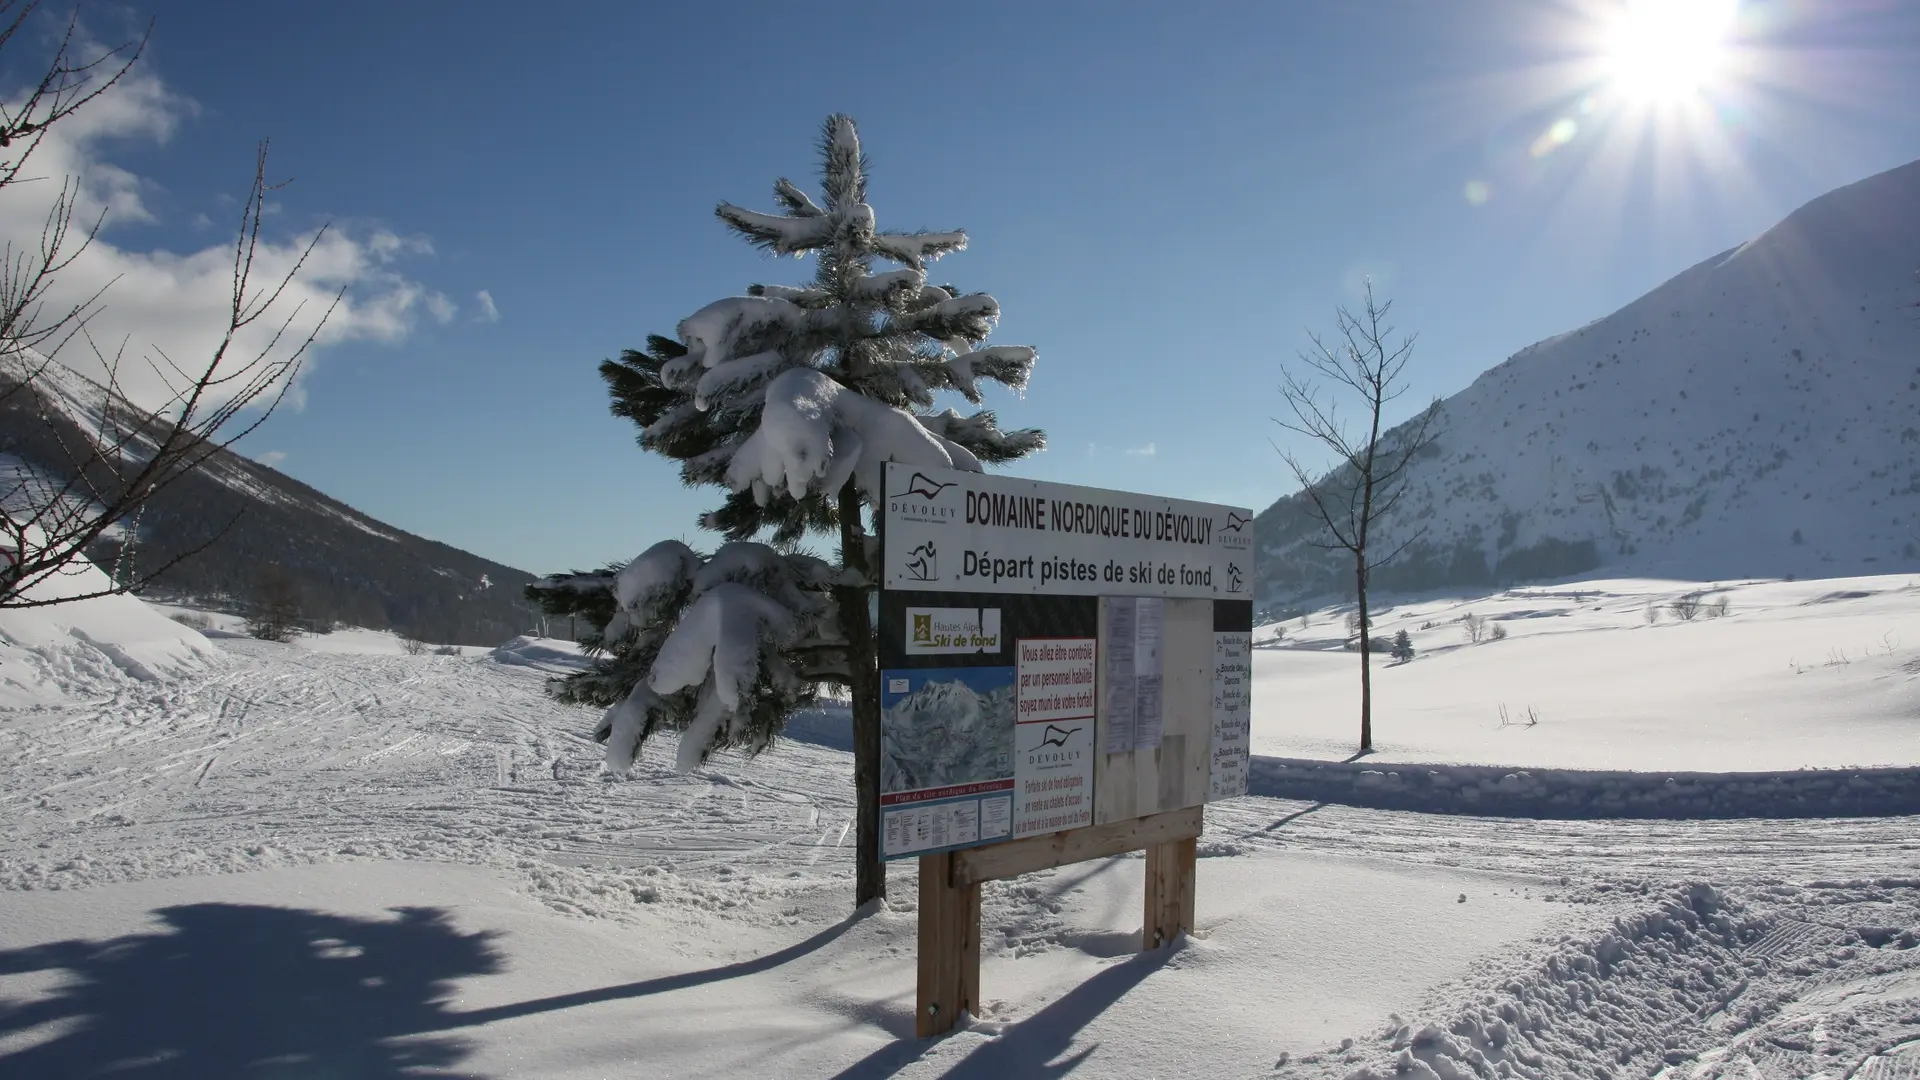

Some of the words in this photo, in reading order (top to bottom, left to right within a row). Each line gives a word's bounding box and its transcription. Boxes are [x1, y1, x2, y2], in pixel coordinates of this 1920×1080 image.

[966, 490, 1046, 530] DOMAINE
[1051, 499, 1129, 538] NORDIQUE
[1133, 509, 1151, 540] DU
[1156, 506, 1213, 545] DÉVOLUY
[963, 550, 1034, 584] Départ
[1041, 555, 1097, 585] pistes
[1104, 559, 1124, 583] de
[1129, 561, 1152, 584] ski
[1157, 563, 1176, 585] de
[1180, 563, 1212, 587] fond
[934, 621, 961, 632] Hautes
[934, 634, 951, 647] Ski
[953, 634, 967, 647] de
[970, 633, 997, 647] fond
[1022, 644, 1038, 661] Vous
[1039, 644, 1054, 661] allez
[1055, 643, 1067, 660] être
[1068, 643, 1092, 660] contrôlé
[1221, 663, 1235, 673] Boucle
[1021, 674, 1031, 691] par
[1032, 673, 1041, 687] un
[1042, 668, 1071, 690] personnel
[1020, 699, 1037, 716] soyez
[1038, 694, 1053, 711] muni
[1054, 693, 1061, 710] de
[1062, 693, 1076, 709] votre
[1076, 691, 1092, 708] forfait
[923, 791, 937, 799] site
[938, 788, 967, 797] nordique
[968, 785, 977, 793] du
